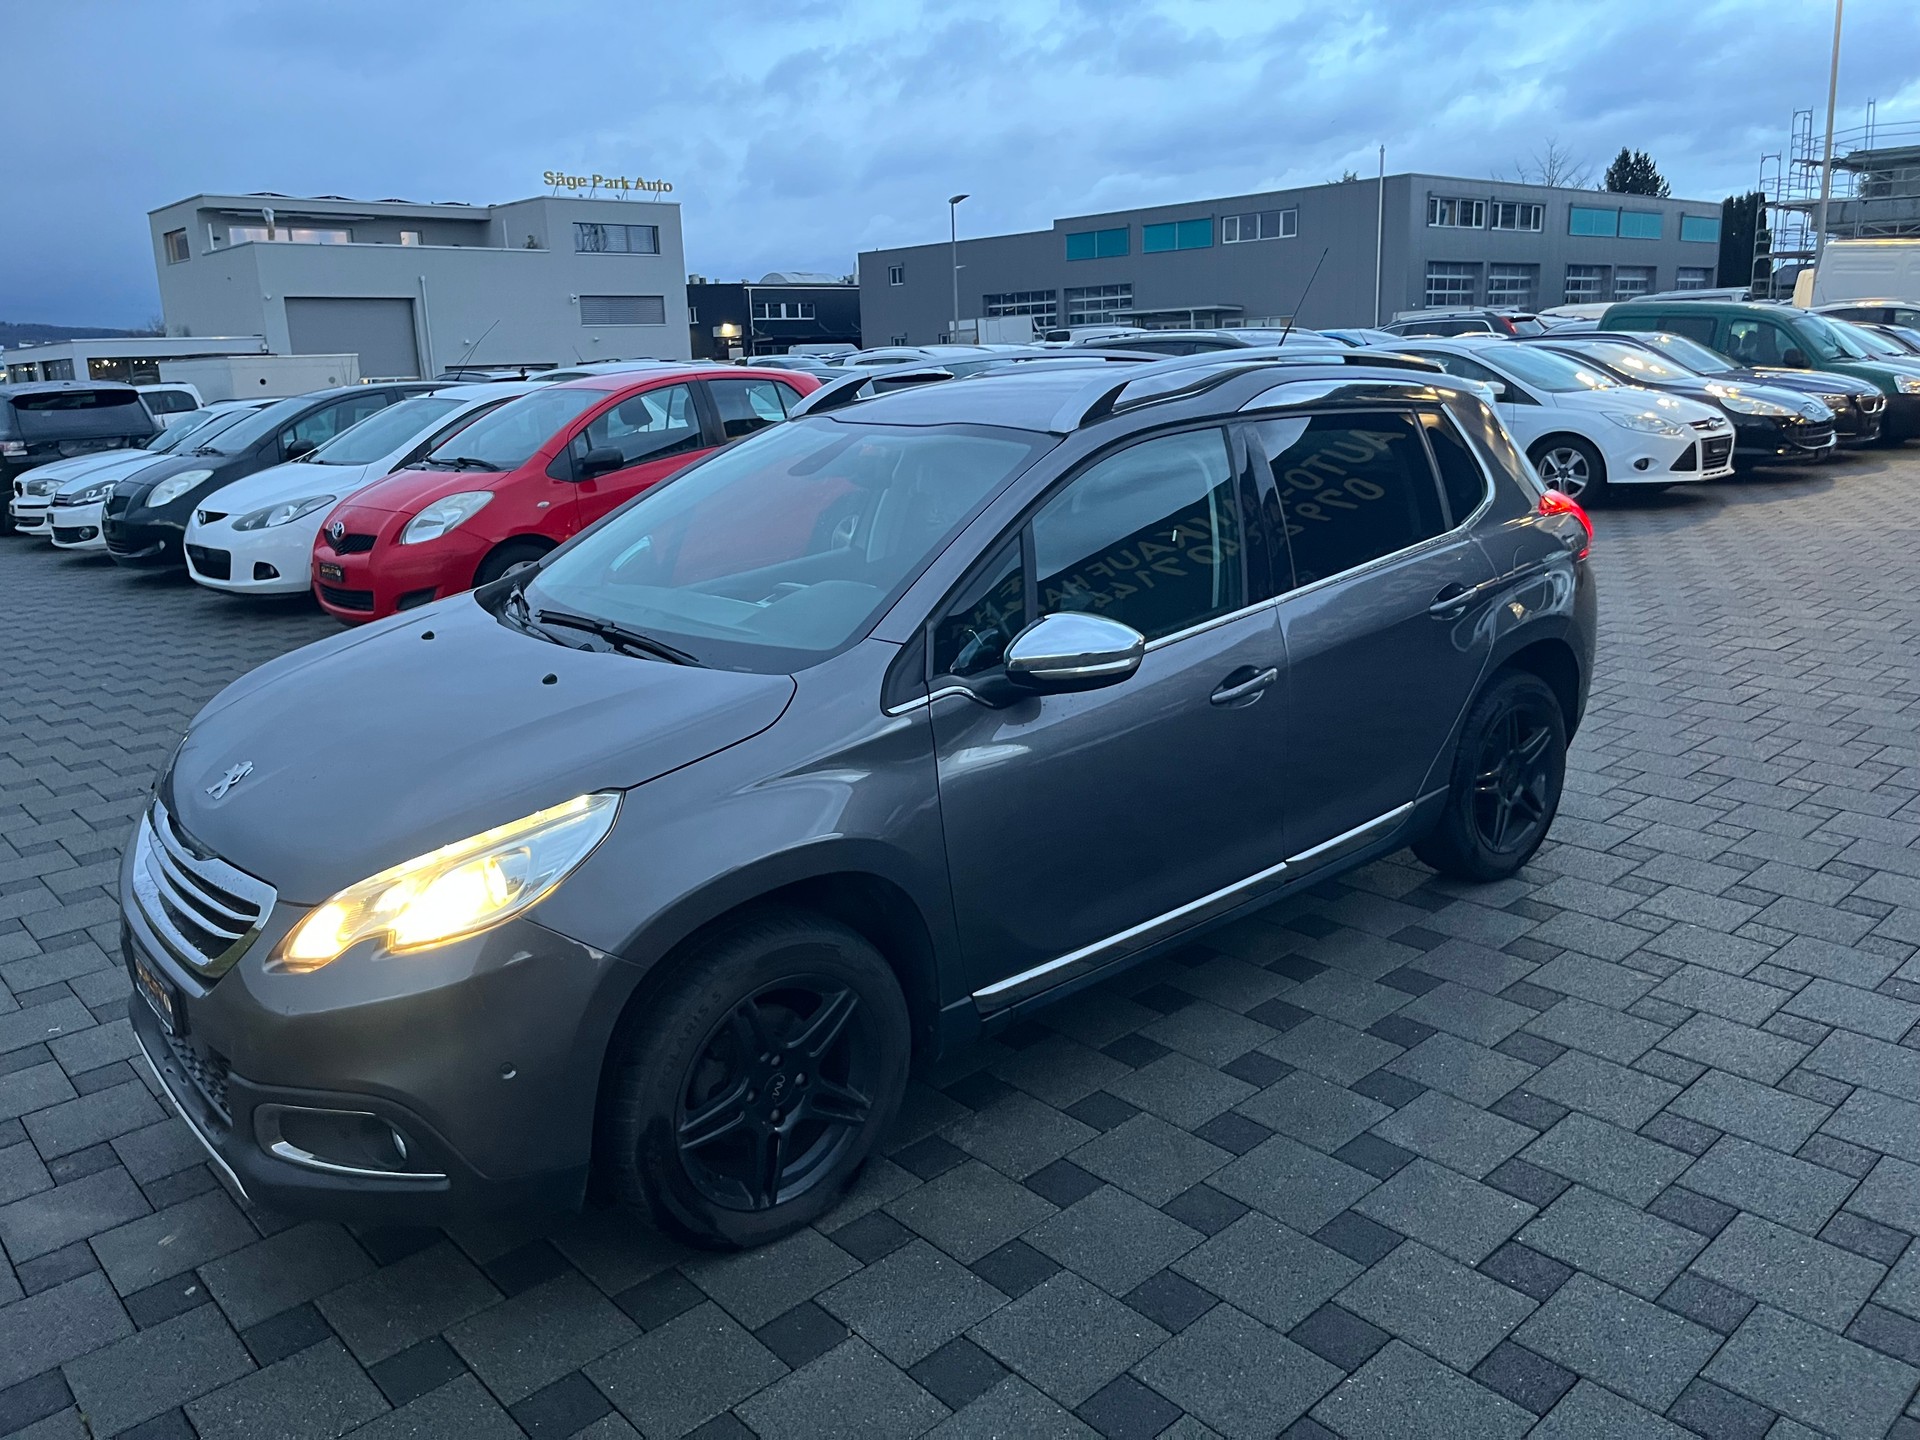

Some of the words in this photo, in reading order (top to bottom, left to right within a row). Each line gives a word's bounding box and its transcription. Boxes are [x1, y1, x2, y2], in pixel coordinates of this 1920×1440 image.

[543, 171, 587, 190] Säge
[592, 174, 629, 189] Park
[635, 177, 673, 193] Auto
